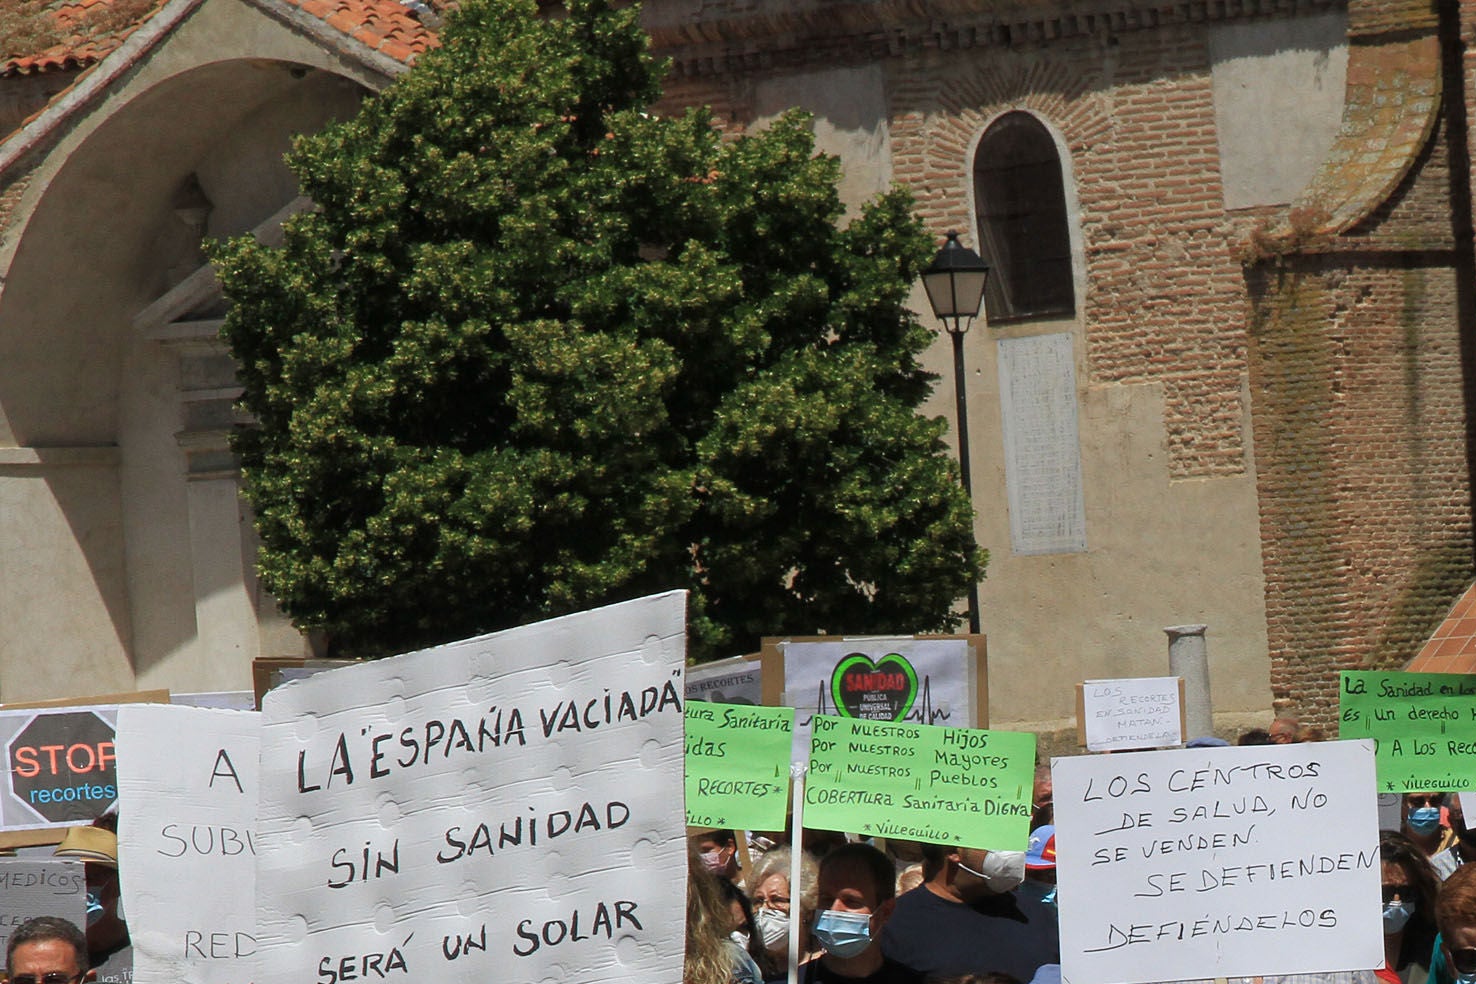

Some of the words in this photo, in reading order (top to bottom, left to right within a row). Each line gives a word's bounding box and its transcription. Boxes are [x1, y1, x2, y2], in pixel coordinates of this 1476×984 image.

[700, 674, 755, 691] RECORTES
[846, 672, 905, 691] SANIDAD
[1377, 679, 1434, 698] Sanidad
[718, 709, 791, 732] Sanitaria
[1408, 706, 1459, 721] derecho
[815, 716, 838, 733] Por
[851, 723, 920, 739] NUESTROS
[944, 729, 989, 750] Hijos
[15, 743, 116, 778] STOP
[812, 738, 837, 754] Por
[849, 742, 915, 756] NUESTROS
[935, 750, 1009, 771] Mayores
[1392, 741, 1402, 756] A
[209, 748, 244, 793] A
[299, 732, 354, 794] LA
[810, 759, 832, 775] Por
[847, 763, 911, 777] NUESTROS
[30, 782, 116, 804] recortes
[698, 778, 774, 797] RECORTES
[1084, 773, 1151, 801] LOS
[1095, 813, 1152, 835] DE
[1292, 787, 1328, 810] NO
[328, 838, 399, 889] SIN
[437, 801, 630, 864] SANIDAD
[1092, 848, 1128, 866] SE
[1134, 872, 1187, 897] SE
[1196, 846, 1379, 892] DEFIENDEN
[442, 924, 487, 961] UN
[513, 900, 643, 957] SOLAR
